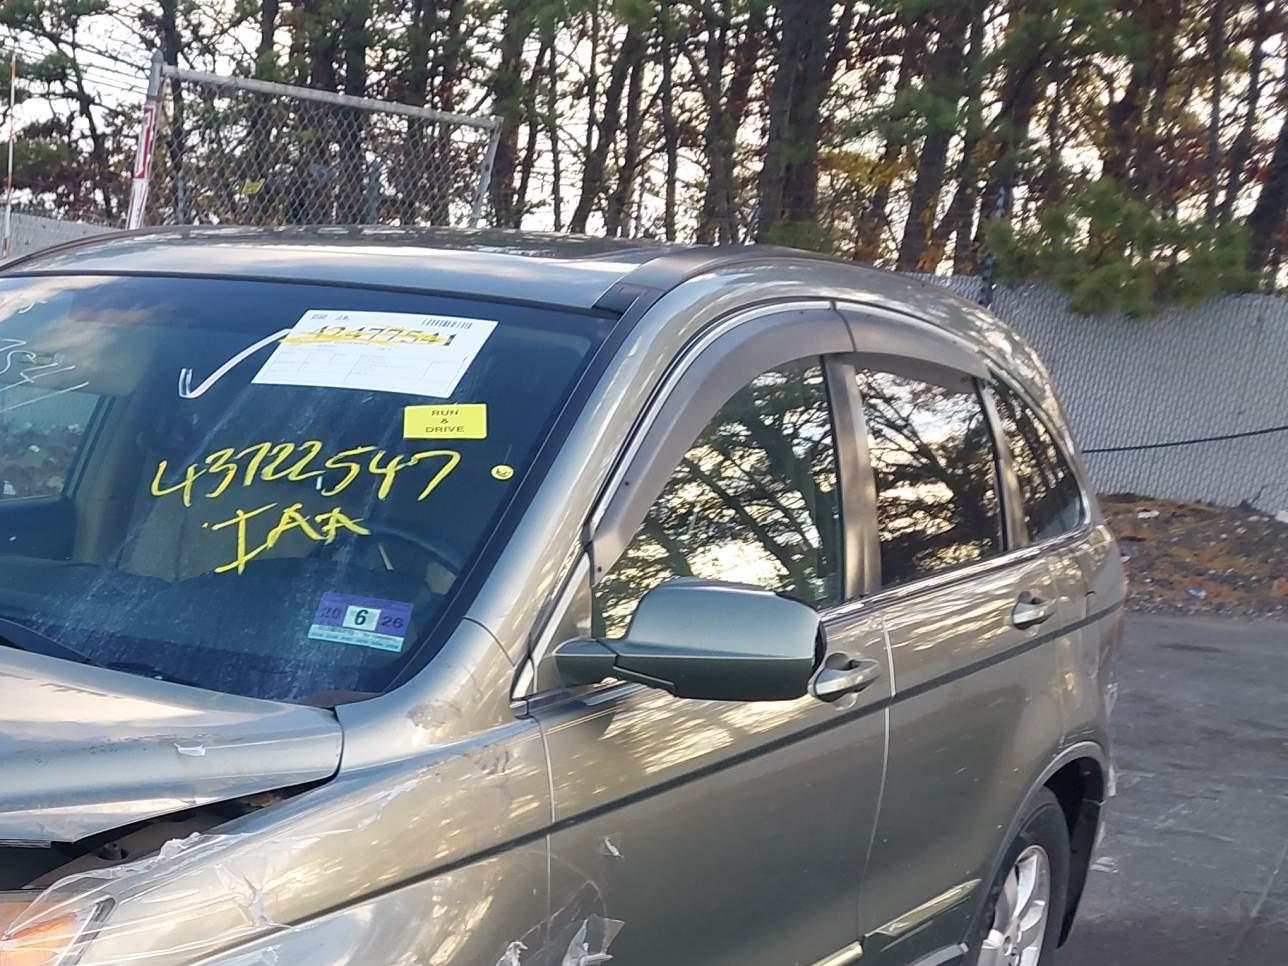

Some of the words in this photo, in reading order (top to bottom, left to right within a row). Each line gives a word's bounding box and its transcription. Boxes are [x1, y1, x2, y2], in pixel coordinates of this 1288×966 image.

[151, 440, 462, 507] 43722547
[354, 609, 369, 626] 6
[382, 615, 404, 629] 26
